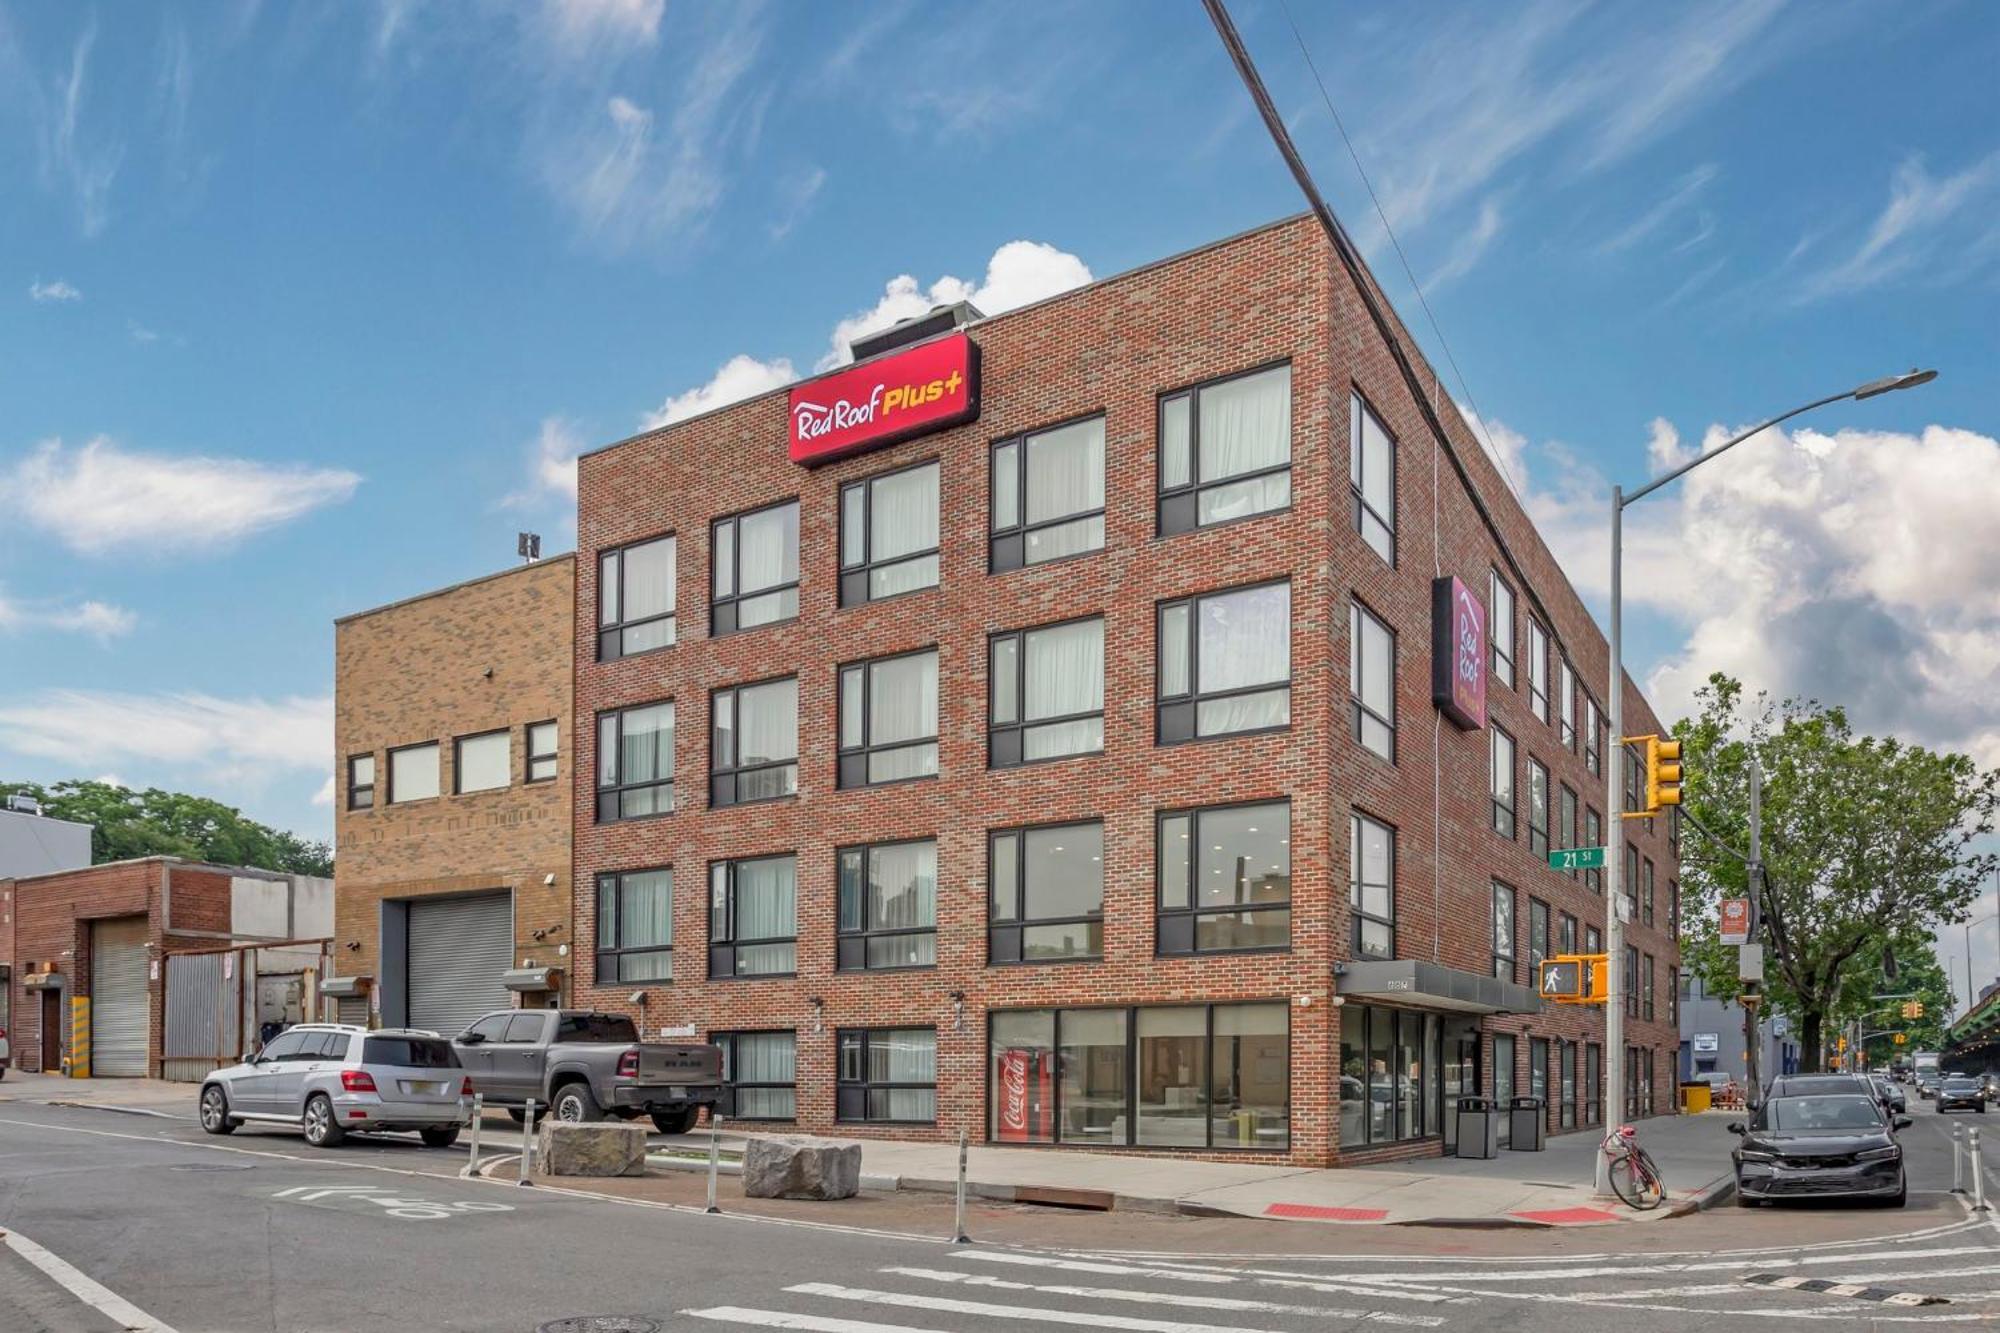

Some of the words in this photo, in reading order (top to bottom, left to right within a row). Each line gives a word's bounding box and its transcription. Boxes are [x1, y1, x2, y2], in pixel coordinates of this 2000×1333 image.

[797, 408, 834, 440] Red
[834, 385, 884, 429] Roof
[882, 370, 962, 416] Plus+
[1459, 612, 1478, 656] Red
[1459, 644, 1481, 693] Roof
[1563, 852, 1577, 867] 21
